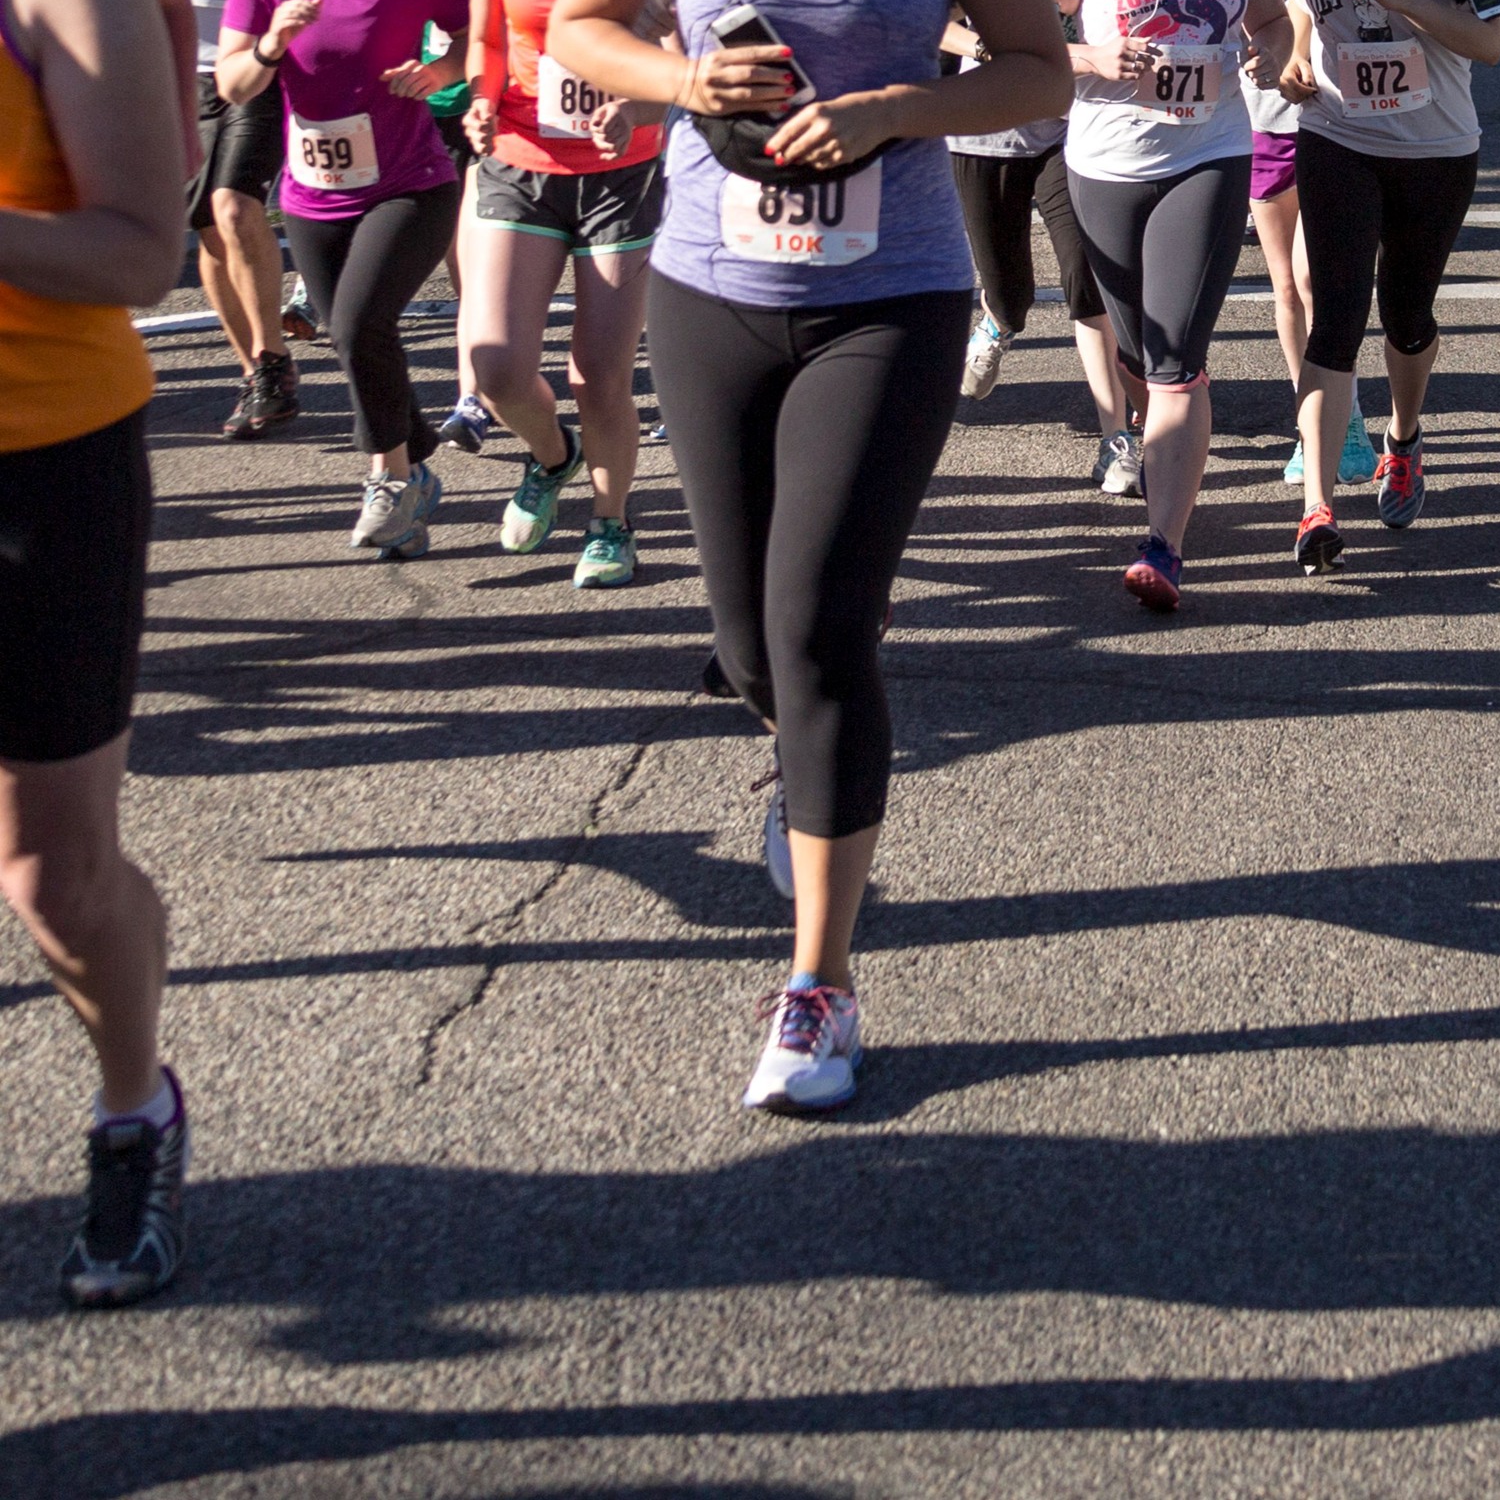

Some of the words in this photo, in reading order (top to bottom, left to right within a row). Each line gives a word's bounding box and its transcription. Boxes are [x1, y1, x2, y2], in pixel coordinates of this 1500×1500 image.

[1156, 65, 1205, 102] 871
[1356, 60, 1409, 96] 872
[1166, 106, 1196, 118] 10K
[1370, 97, 1400, 110] 10K
[302, 137, 353, 170] 859
[316, 173, 344, 184] 10K
[776, 233, 824, 253] 10K
